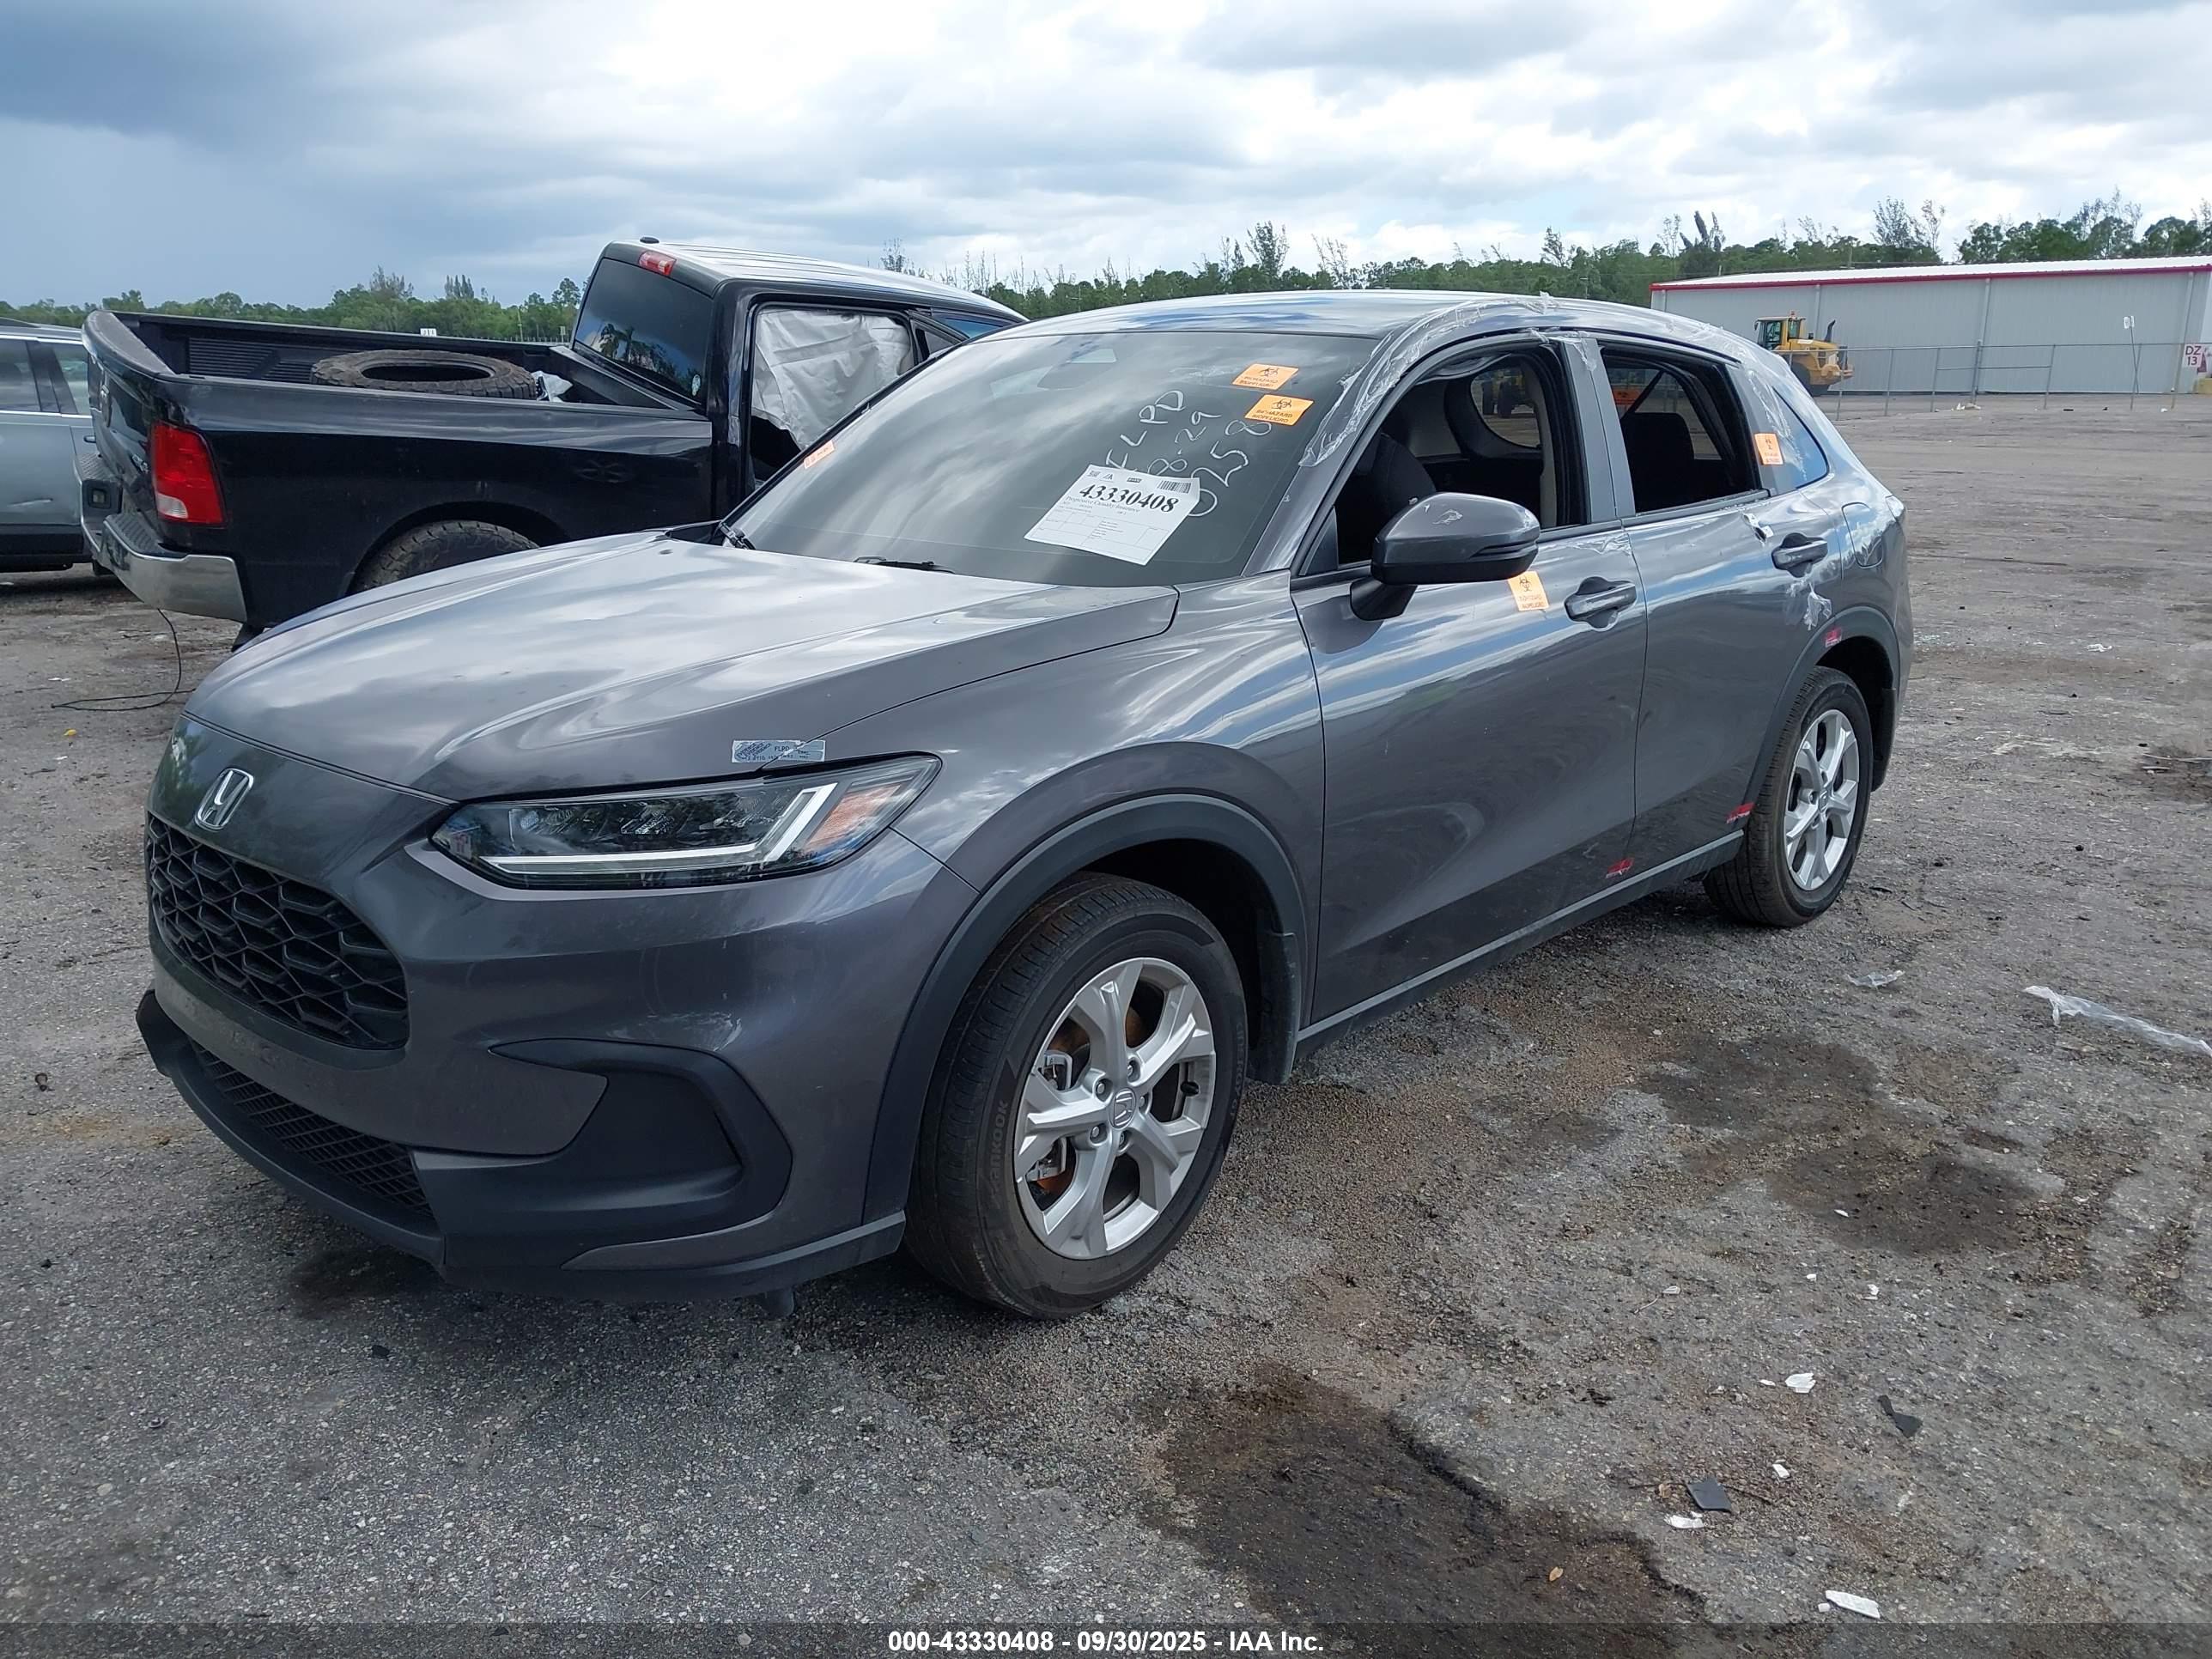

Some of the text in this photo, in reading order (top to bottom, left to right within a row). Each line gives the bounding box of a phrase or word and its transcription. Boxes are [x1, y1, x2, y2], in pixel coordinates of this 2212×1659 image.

[2185, 345, 2202, 356] DZ
[2187, 356, 2198, 366] 13
[1079, 483, 1180, 513] 43330408
